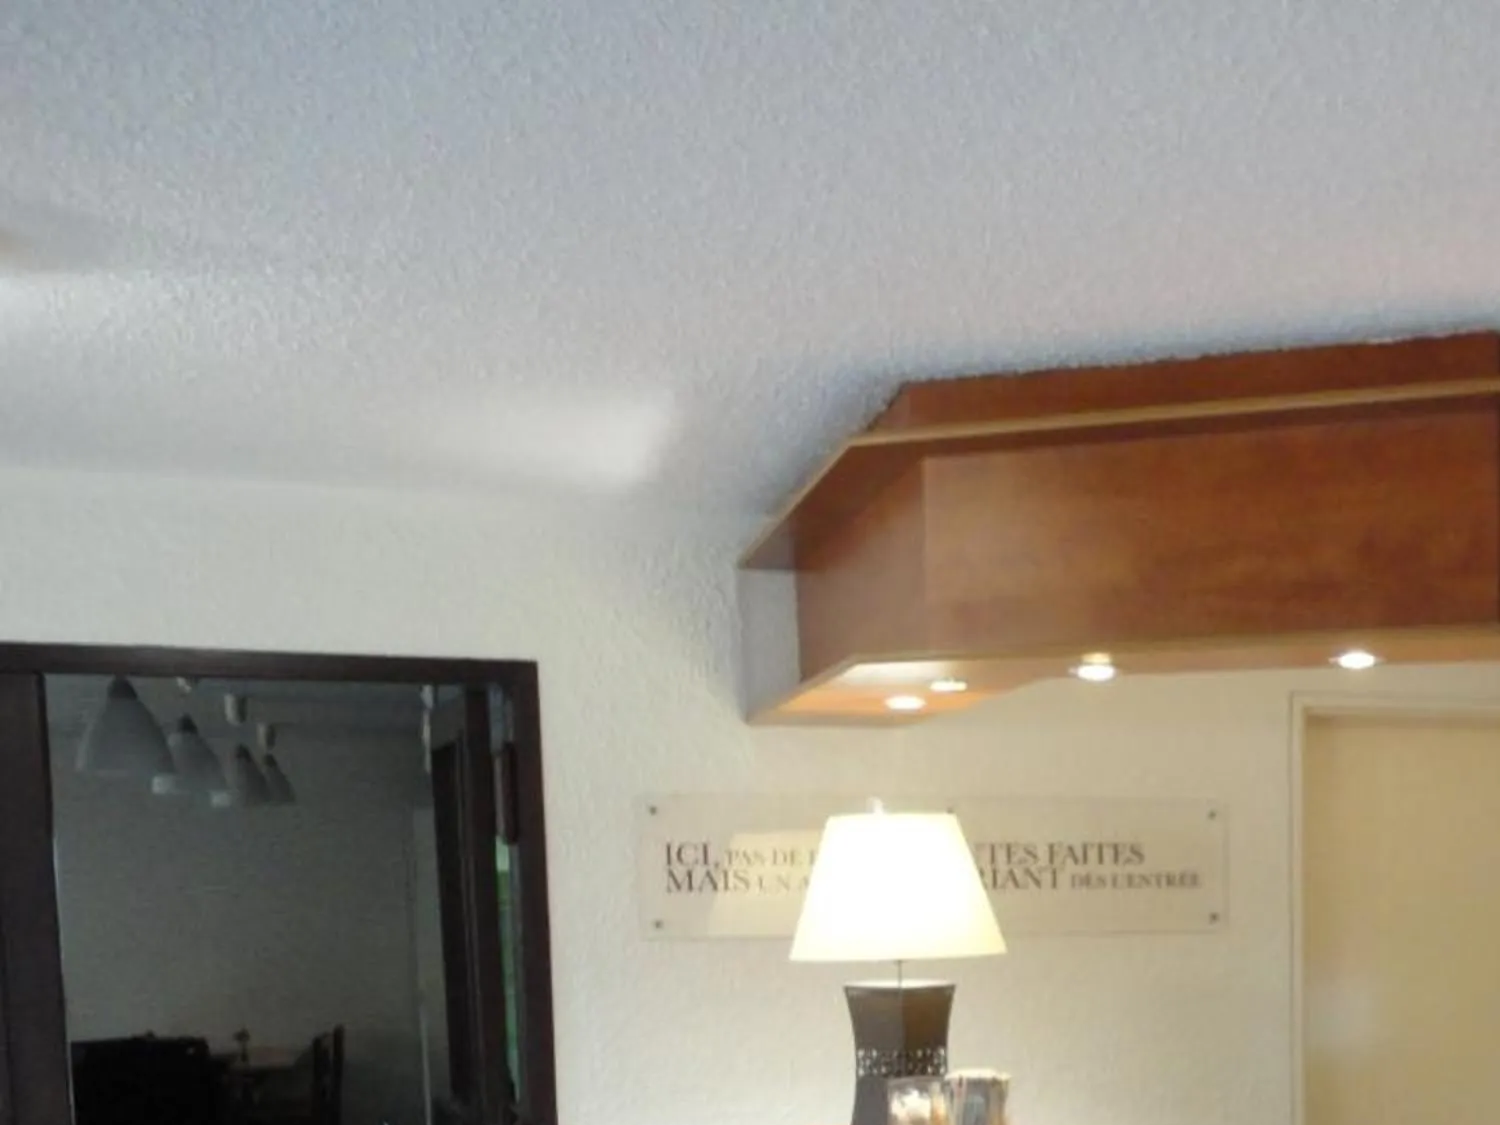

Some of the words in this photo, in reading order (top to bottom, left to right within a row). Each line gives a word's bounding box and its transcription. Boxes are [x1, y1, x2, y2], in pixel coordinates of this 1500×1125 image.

[665, 841, 720, 869] ICI,
[725, 848, 767, 866] PAS
[772, 847, 803, 866] DE
[1047, 842, 1146, 865] FAITES
[665, 868, 751, 893] MAIS
